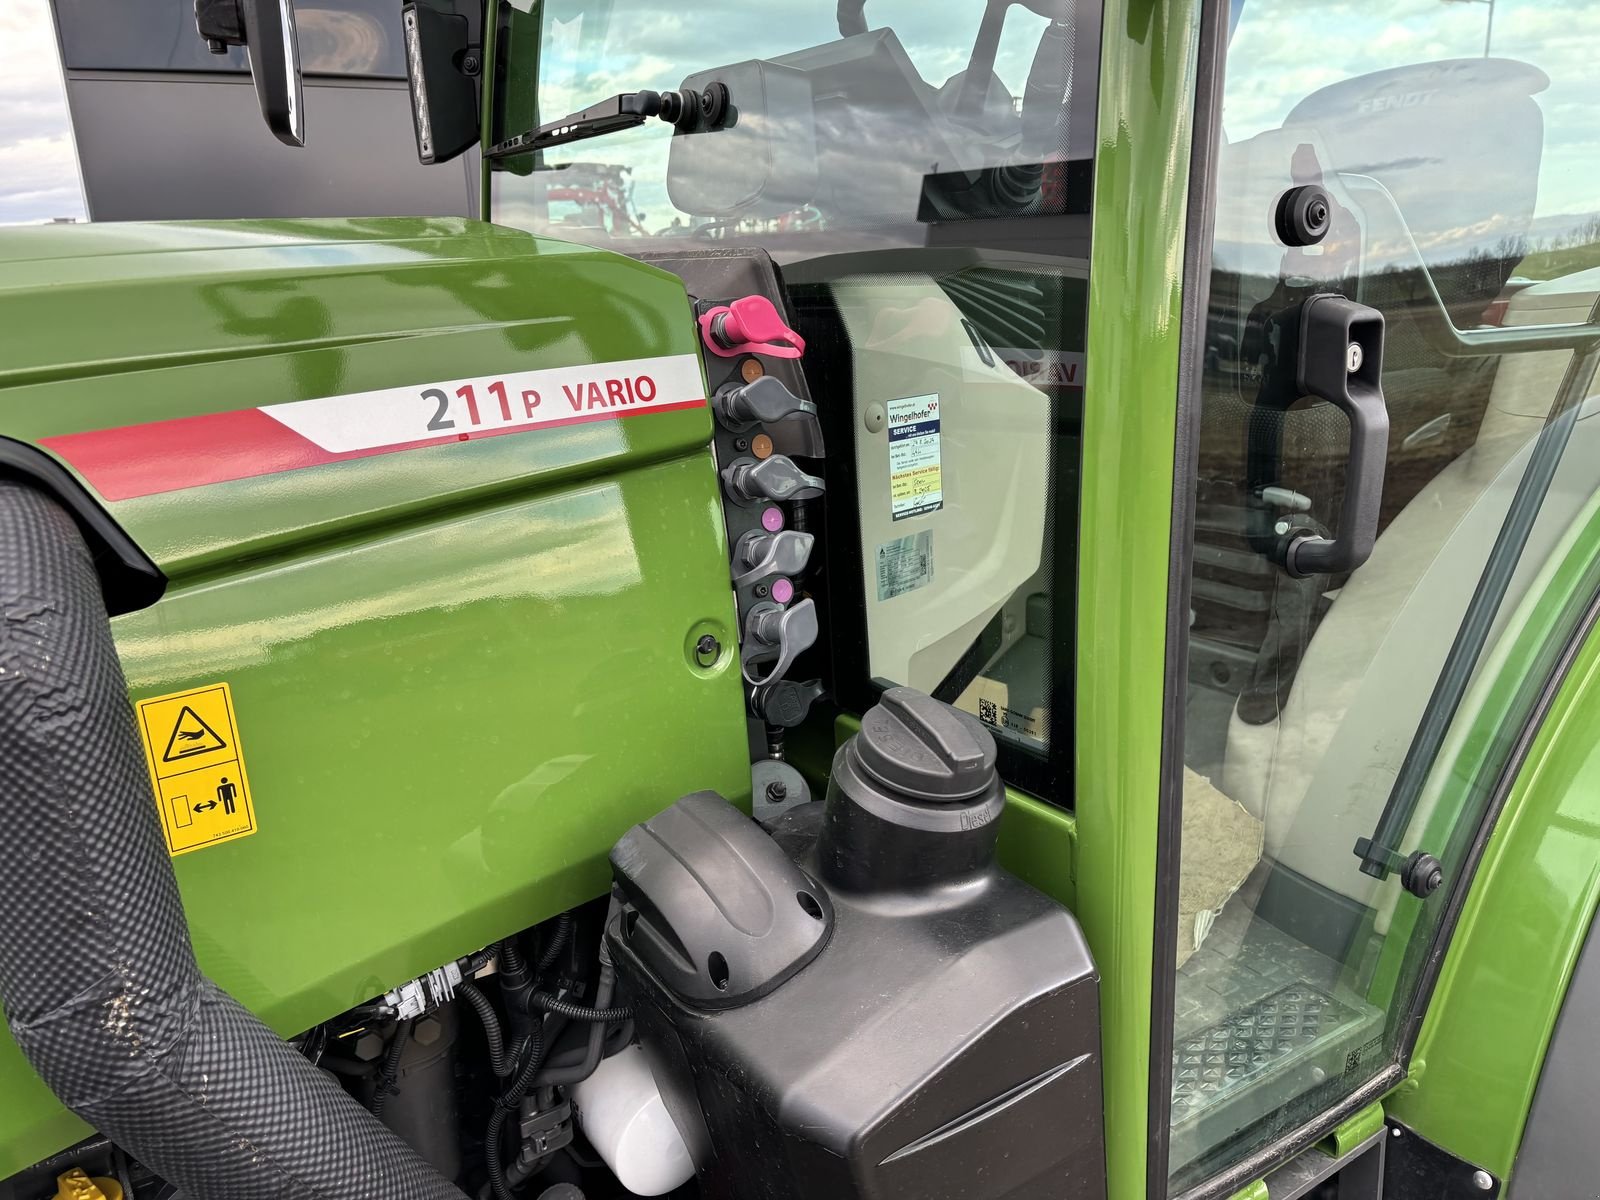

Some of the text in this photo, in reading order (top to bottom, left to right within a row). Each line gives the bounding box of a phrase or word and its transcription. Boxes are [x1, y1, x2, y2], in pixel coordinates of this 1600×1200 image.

[1358, 88, 1440, 113] FENDT
[562, 375, 657, 412] VARIO
[889, 410, 931, 423] Wingelhofer
[893, 425, 917, 436] SERVICE
[959, 803, 992, 831] Diesel
